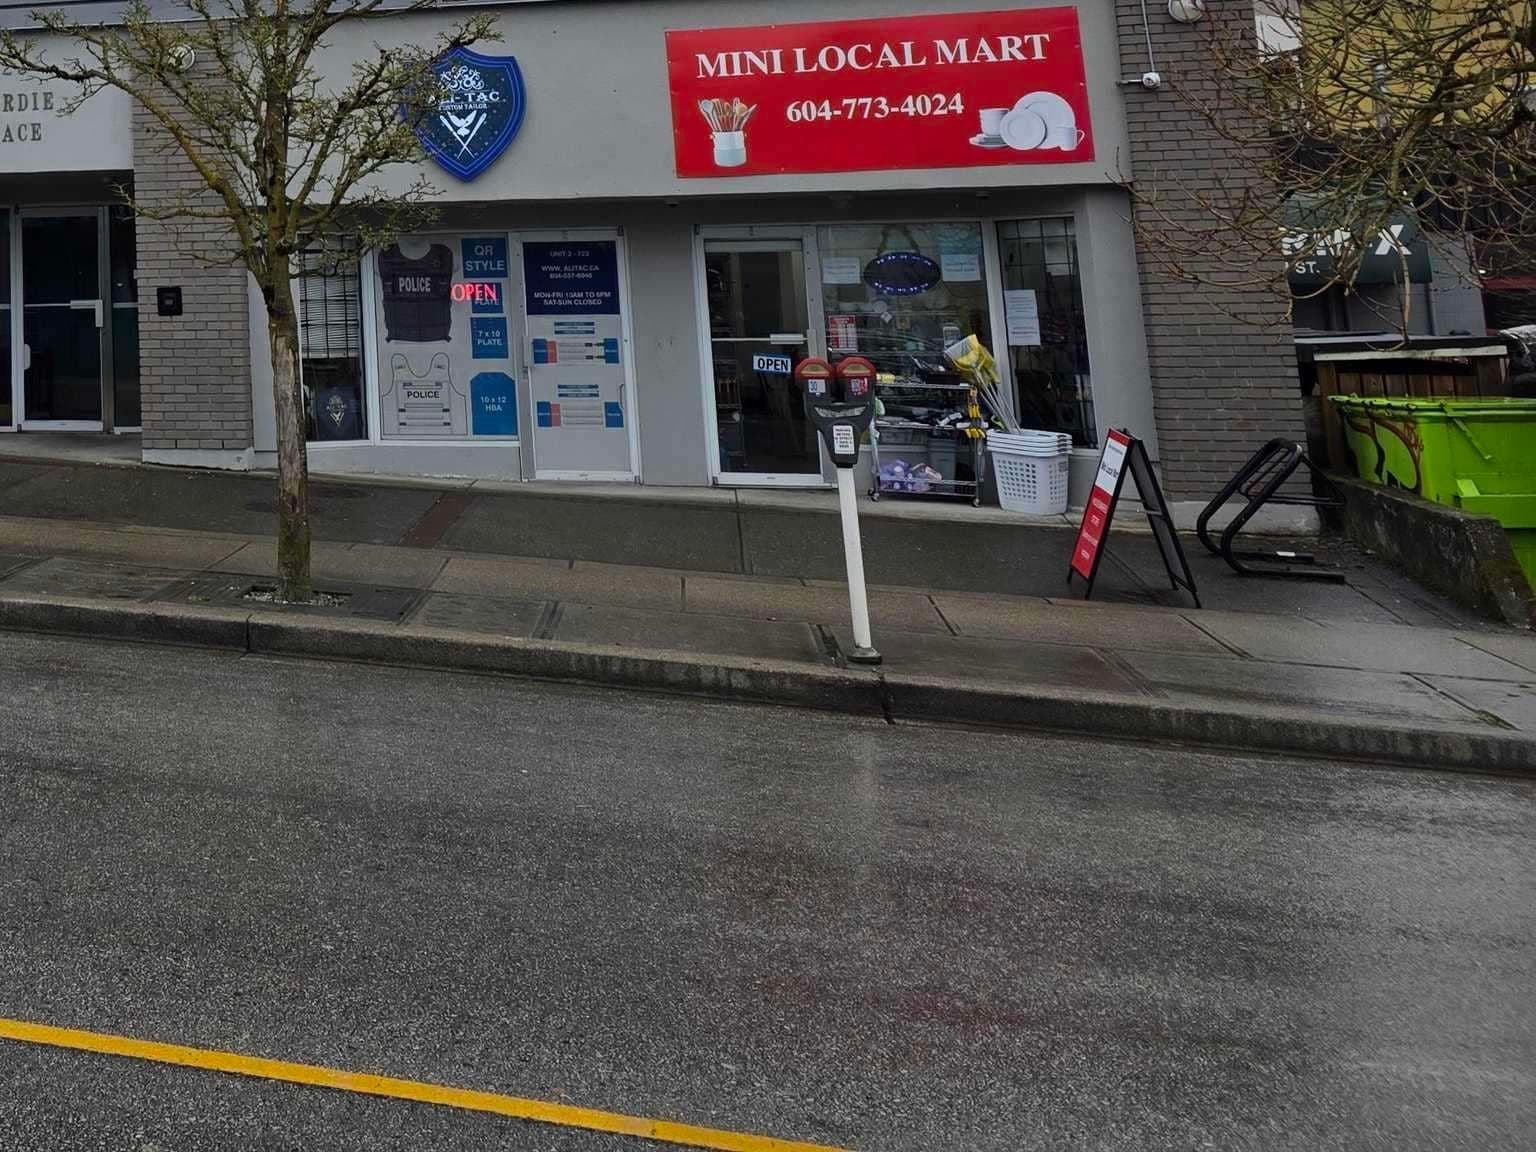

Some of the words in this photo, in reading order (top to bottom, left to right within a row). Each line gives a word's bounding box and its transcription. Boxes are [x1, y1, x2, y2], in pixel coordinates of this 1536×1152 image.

[695, 48, 785, 79] MINI
[793, 41, 927, 72] LOCAL
[933, 33, 1050, 65] MART
[786, 93, 964, 122] 604-773-4024
[474, 245, 493, 256] QR
[465, 260, 504, 271] STYLE
[1295, 261, 1320, 274] ST.
[398, 277, 431, 292] POLICE
[451, 283, 497, 302] OPEN
[757, 358, 788, 371] OPEN
[407, 391, 440, 399] POLICE
